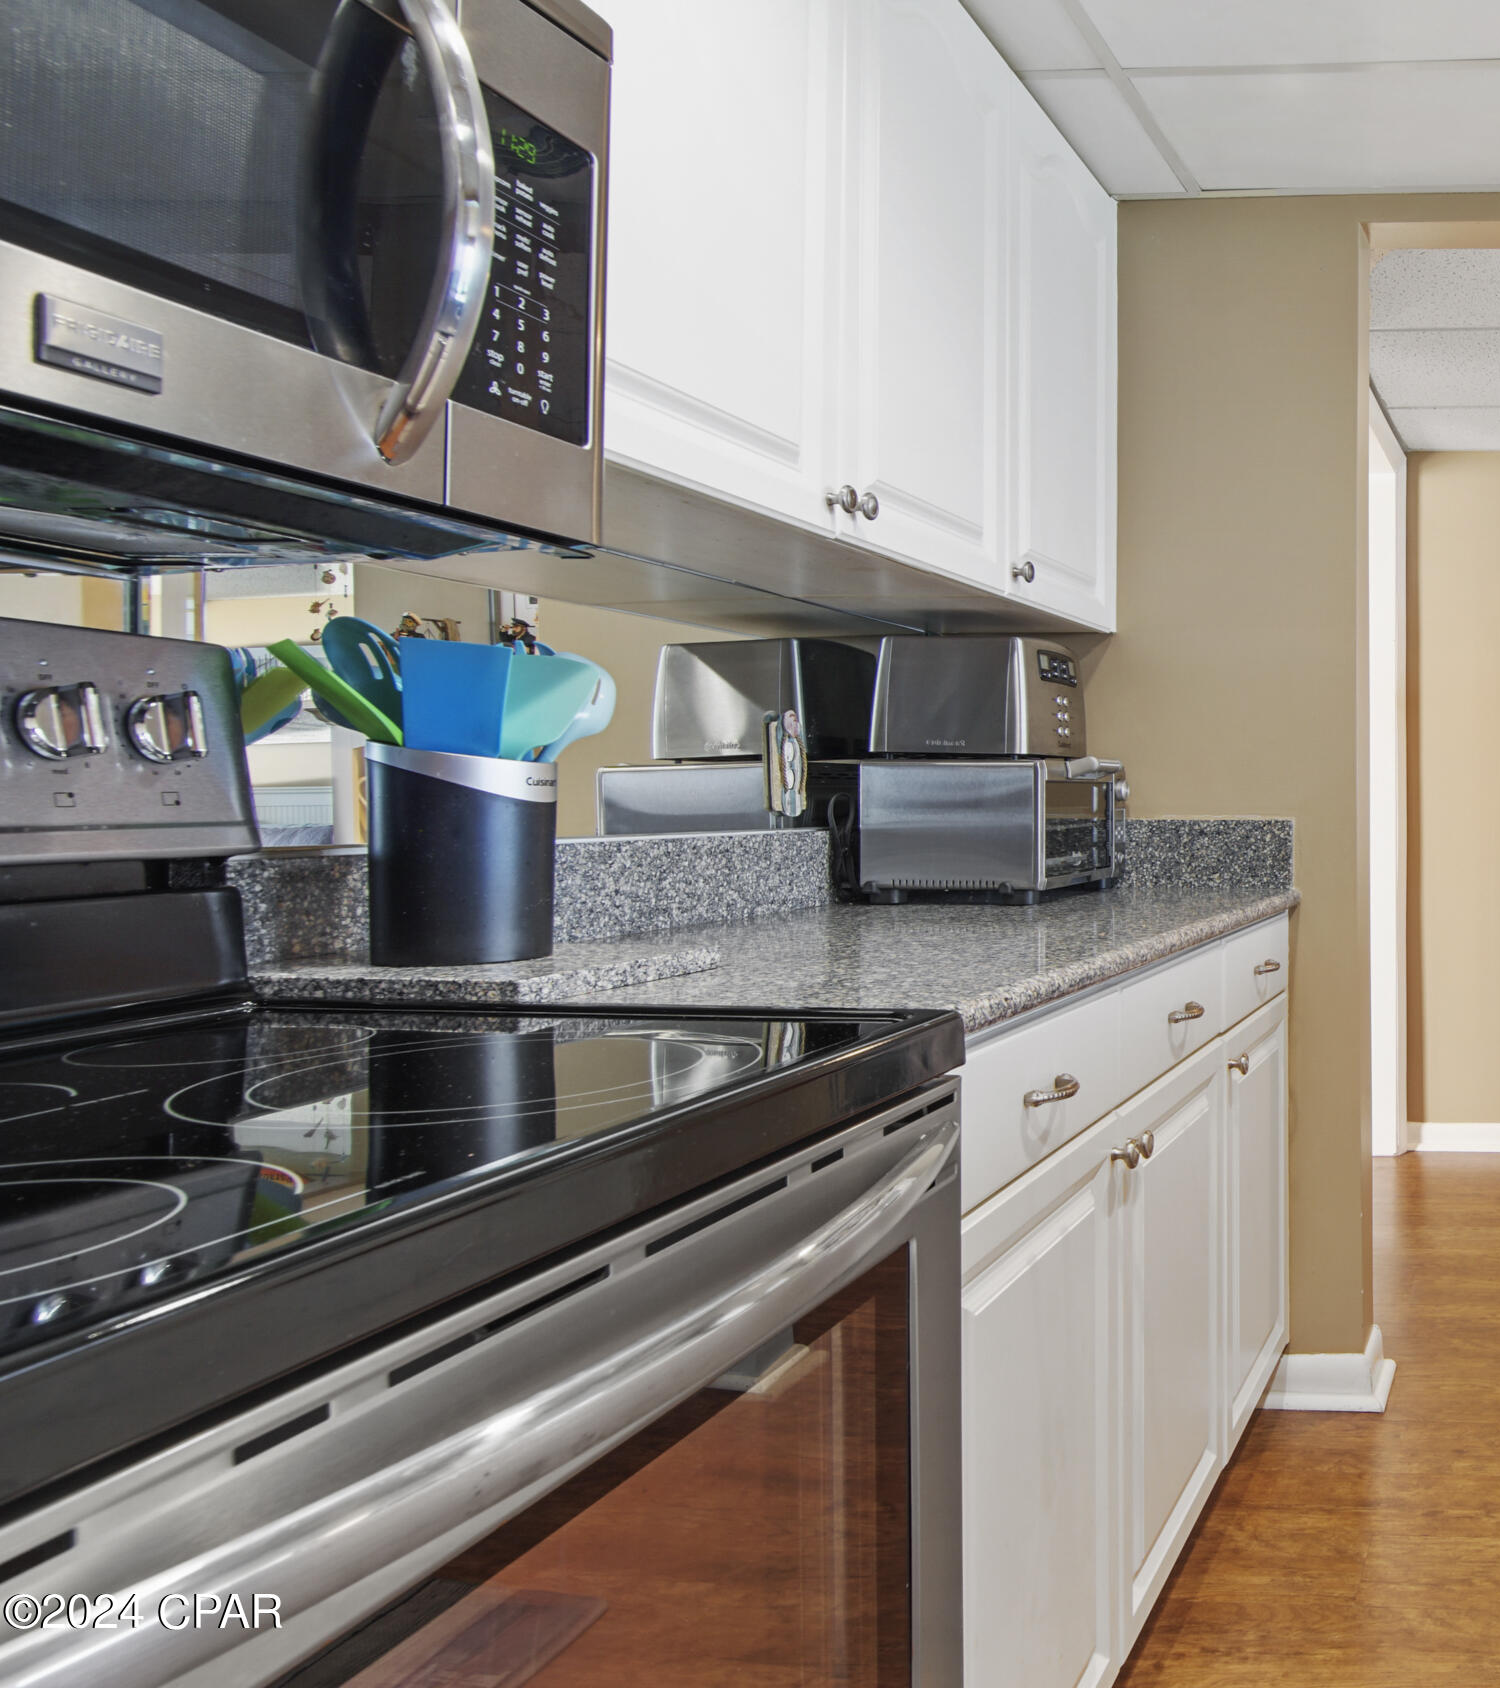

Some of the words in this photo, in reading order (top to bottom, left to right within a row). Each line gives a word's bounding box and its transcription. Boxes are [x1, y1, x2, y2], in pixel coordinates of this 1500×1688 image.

[493, 285, 500, 298] 1
[517, 296, 526, 310] 2
[542, 308, 551, 321] 3
[52, 312, 161, 359] FRIGIDAIRE
[491, 308, 501, 321] 4
[516, 319, 526, 331] 5
[541, 331, 550, 343] 6
[491, 329, 500, 341] 7
[516, 341, 526, 353] 8
[541, 352, 550, 363] 9
[71, 357, 137, 381] GALLERY
[516, 362, 525, 375] 0
